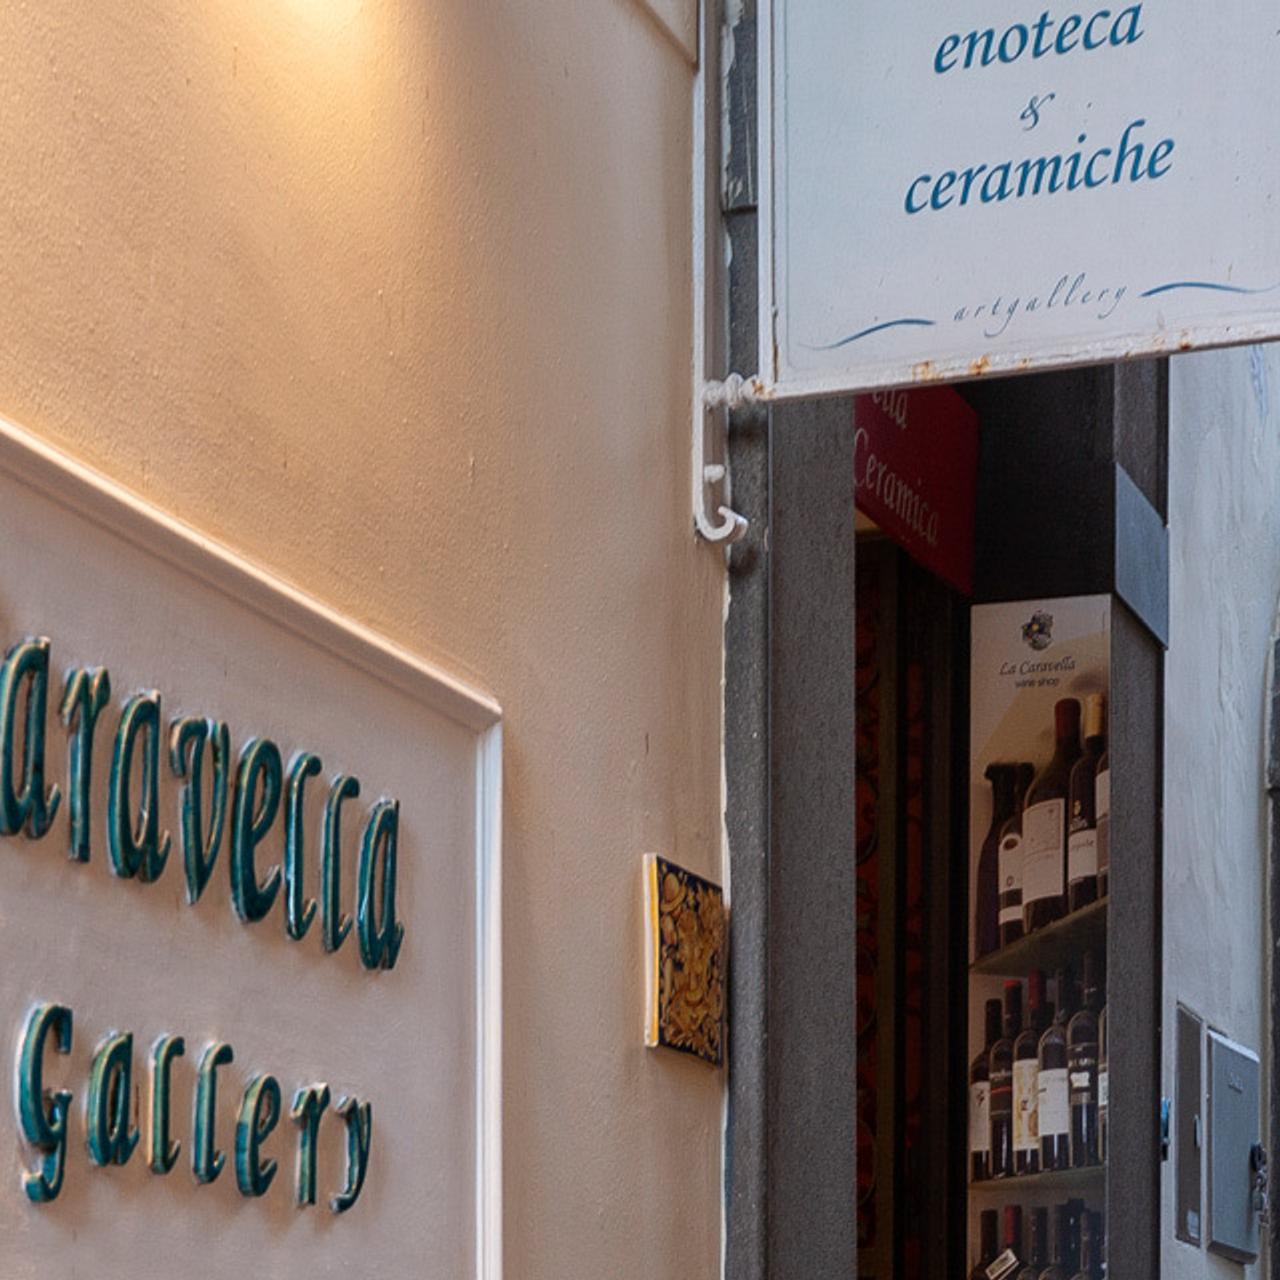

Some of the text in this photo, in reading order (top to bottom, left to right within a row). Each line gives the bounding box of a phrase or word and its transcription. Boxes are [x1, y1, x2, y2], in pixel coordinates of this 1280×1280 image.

[932, 3, 1144, 74] enoteca
[1019, 92, 1055, 131] &
[903, 119, 1175, 214] ceramiche
[854, 427, 940, 547] Ceramica
[999, 661, 1017, 676] La
